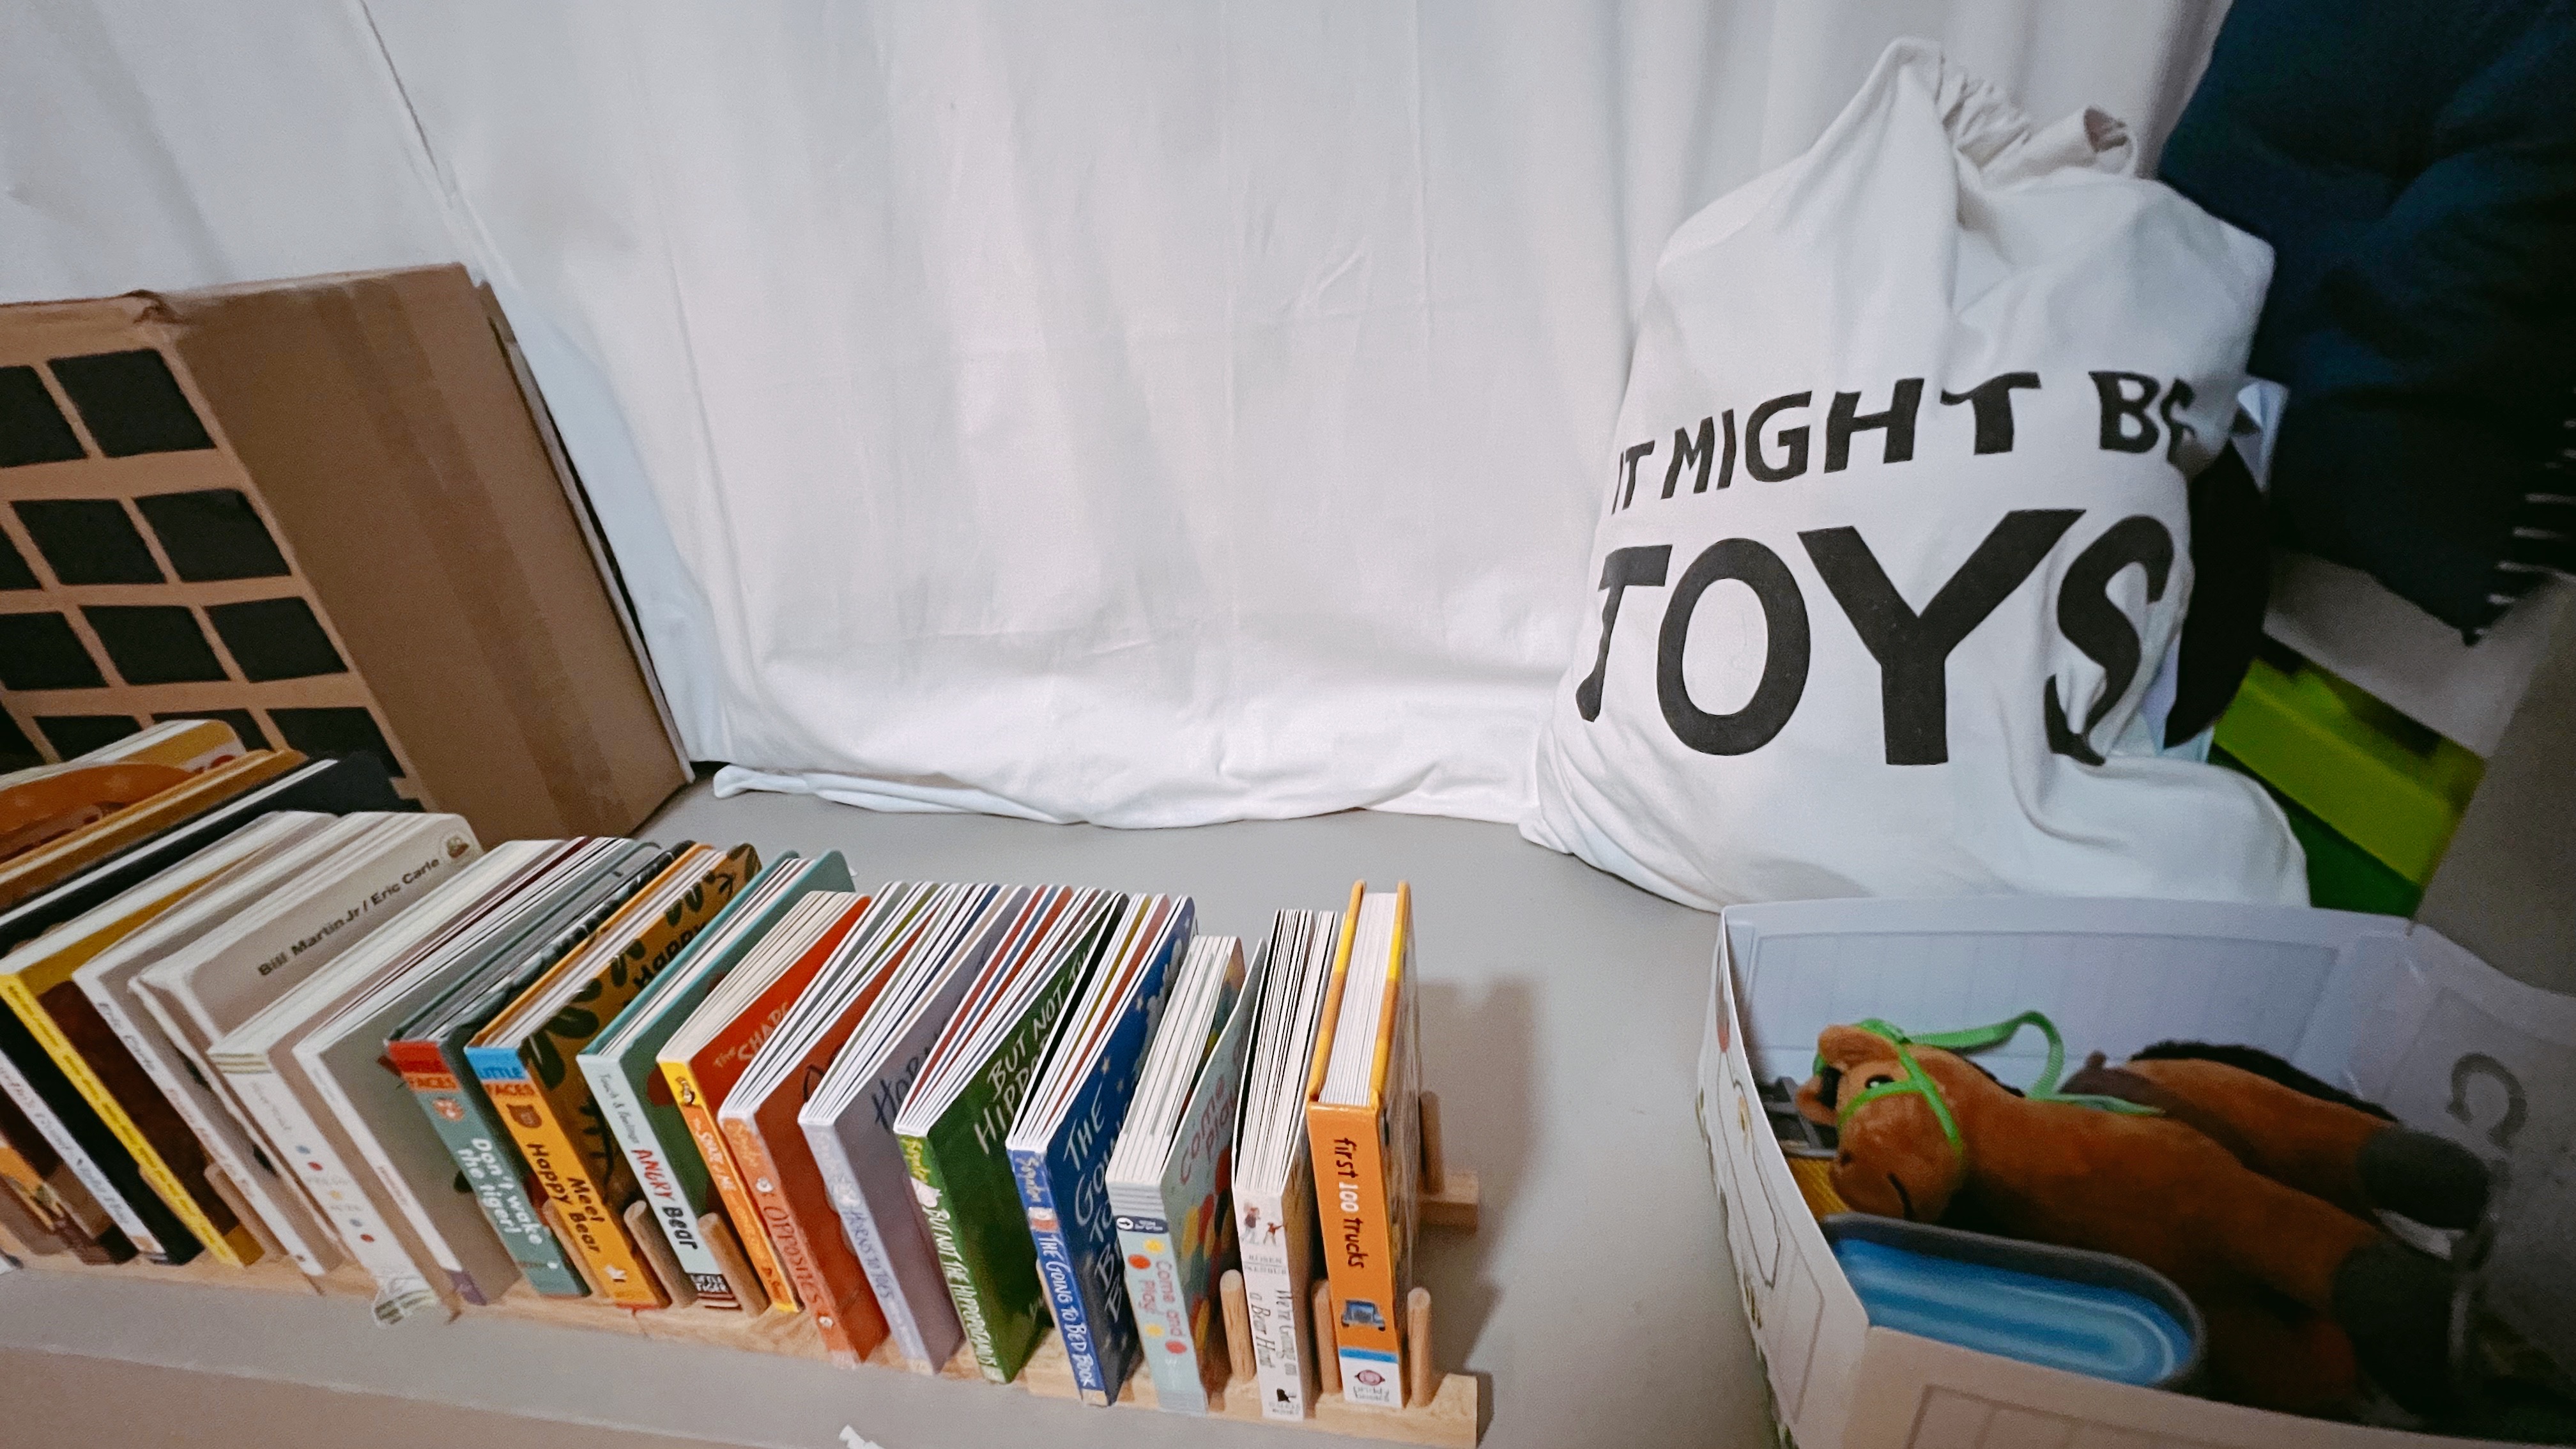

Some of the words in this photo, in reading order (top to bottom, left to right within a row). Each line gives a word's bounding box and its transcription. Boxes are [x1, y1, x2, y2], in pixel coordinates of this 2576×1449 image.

[1612, 440, 1655, 514] IT
[1661, 372, 2042, 500] MIGHT
[1575, 509, 2175, 766] TOYS
[257, 951, 289, 976] Bill
[291, 917, 345, 956] Martin
[346, 907, 360, 922] Jr
[370, 883, 401, 906] Eric
[401, 859, 440, 885] Carle
[987, 1029, 1027, 1103] BUT
[1033, 977, 1065, 1041] NOT
[1062, 1078, 1105, 1172] THE
[1333, 1137, 1358, 1179] first
[457, 1148, 486, 1180] the
[479, 1184, 523, 1233] tiger!
[471, 1137, 514, 1190] Don't
[507, 1194, 543, 1245] wake
[526, 1144, 572, 1208] Happy
[569, 1212, 600, 1253] Bear
[568, 1177, 606, 1222] Meet
[631, 1149, 676, 1201] ANGRY
[662, 1206, 698, 1250] Bear
[1338, 1180, 1360, 1213] 100
[922, 1205, 953, 1236] BUT
[1343, 1216, 1368, 1269] trucks
[764, 1205, 824, 1304] OPPOSITES
[933, 1232, 963, 1262] NOT
[1037, 1232, 1063, 1257] THE
[942, 1259, 970, 1284] THE
[1044, 1256, 1074, 1305] GOING
[1155, 1260, 1176, 1303] Come
[1060, 1303, 1080, 1321] TO
[1250, 1303, 1271, 1335] Bear
[1066, 1321, 1088, 1356] BED
[1070, 1354, 1097, 1388] BOOK
